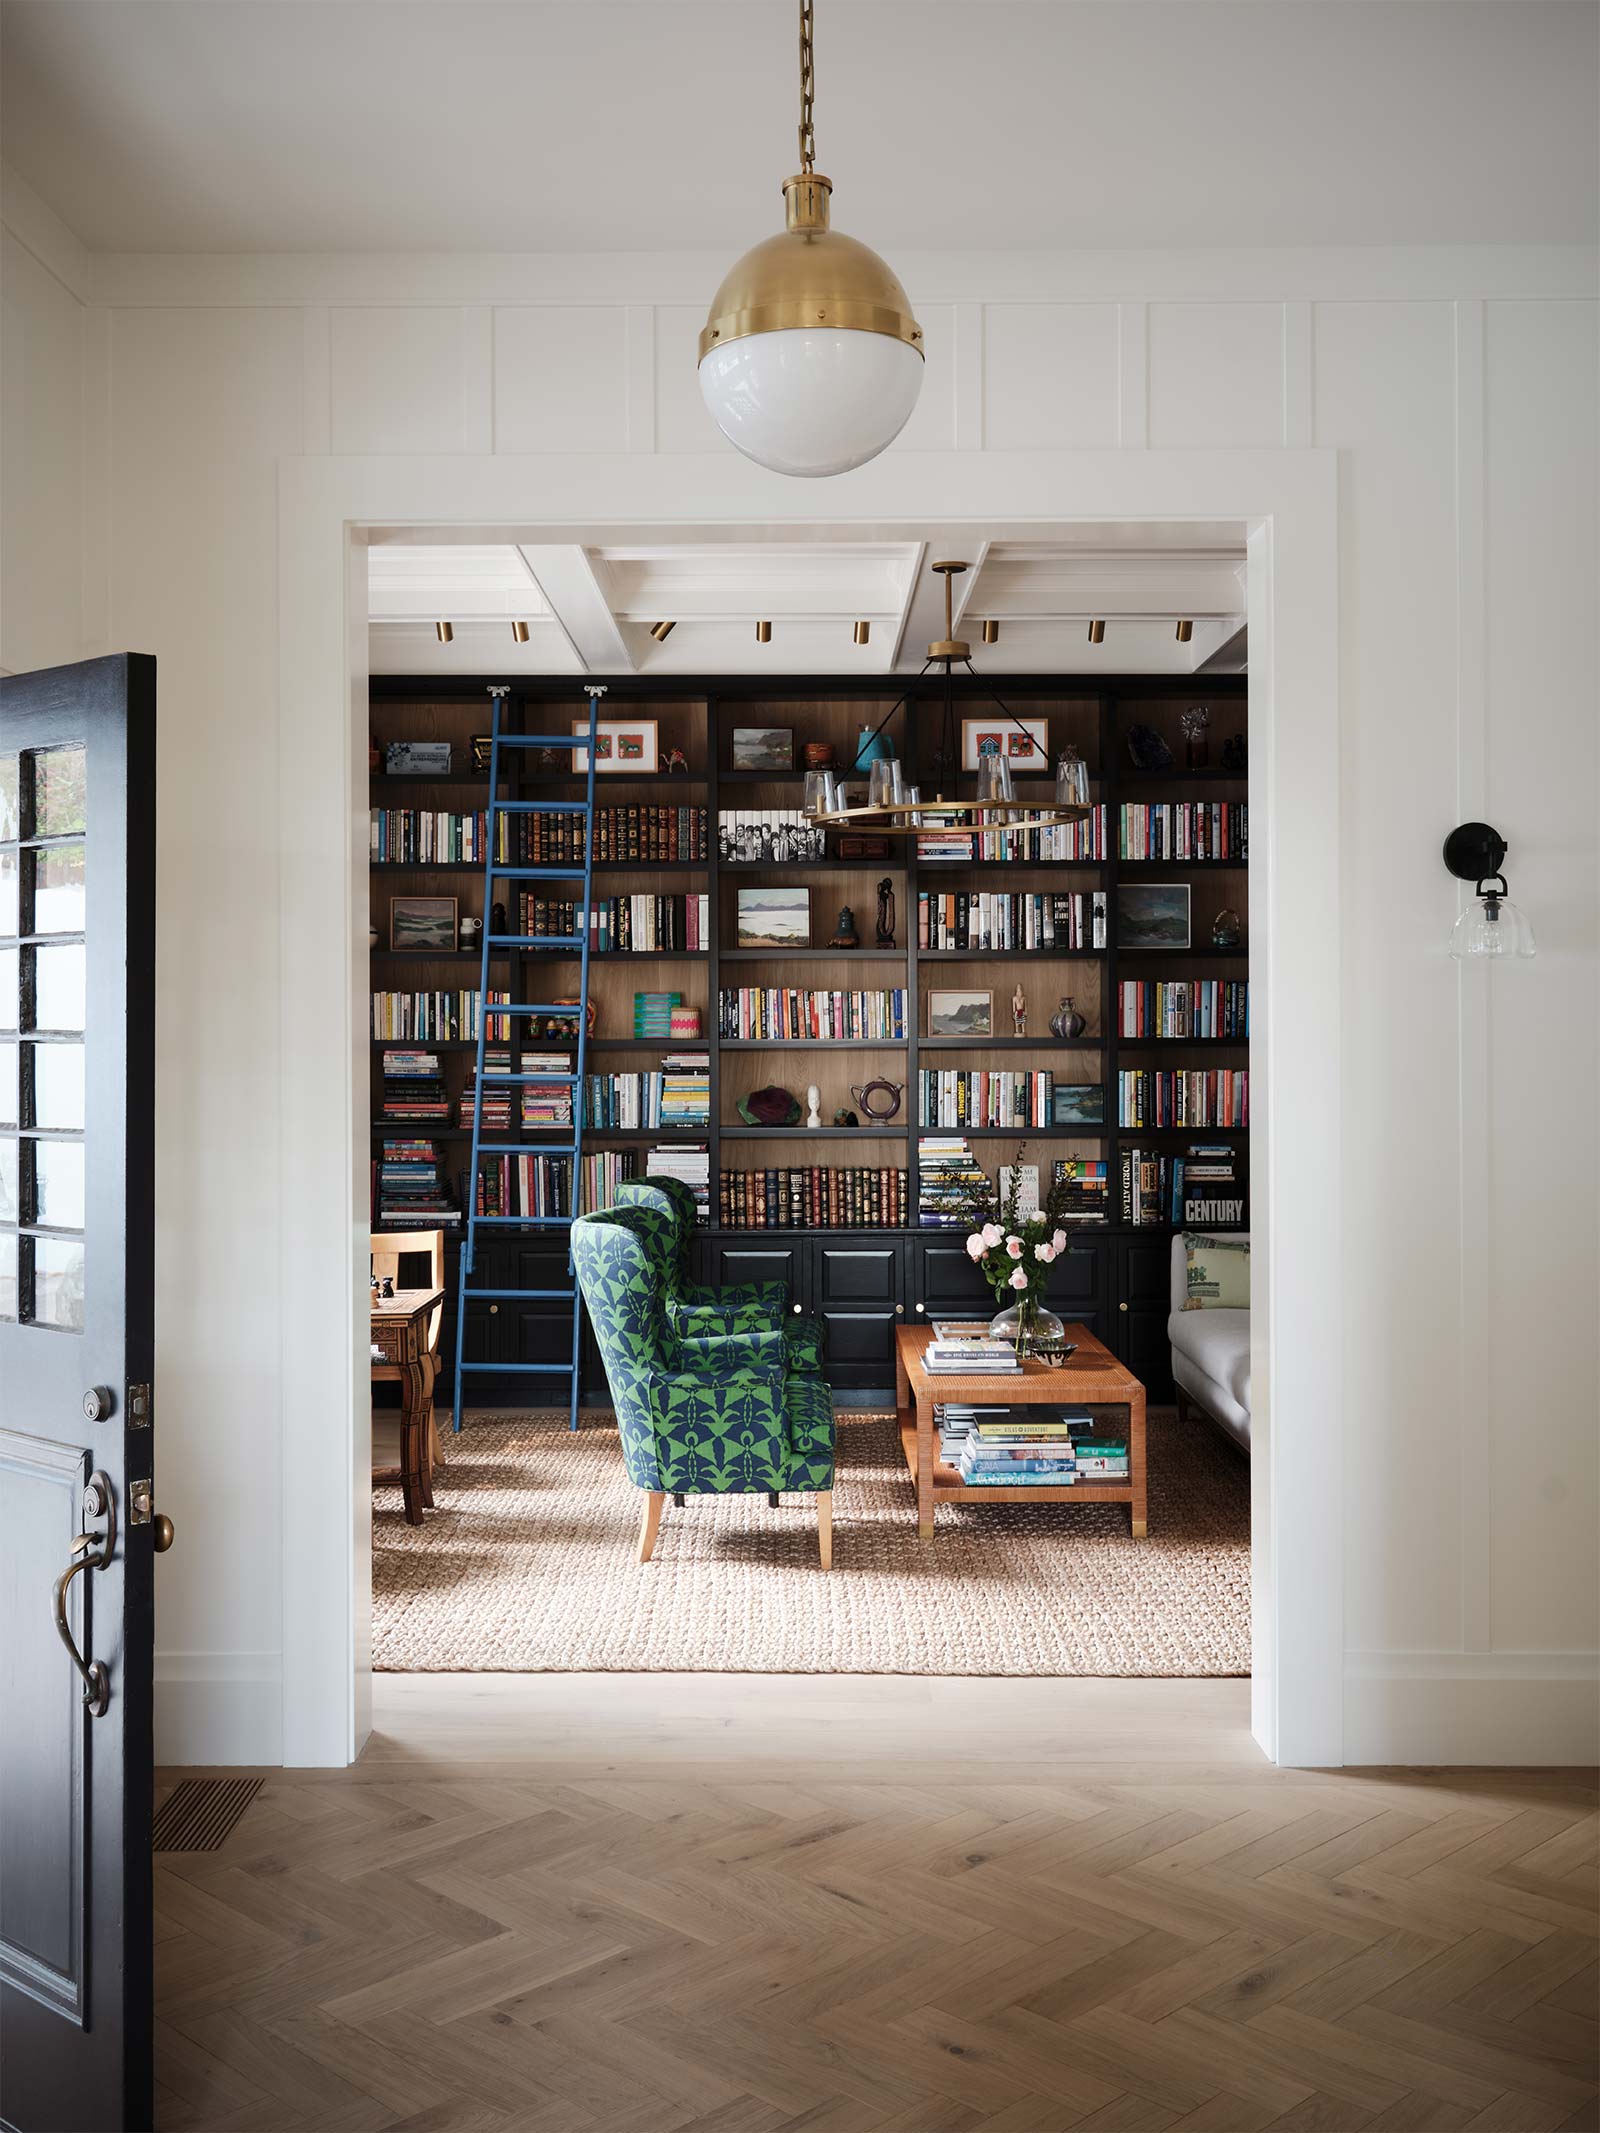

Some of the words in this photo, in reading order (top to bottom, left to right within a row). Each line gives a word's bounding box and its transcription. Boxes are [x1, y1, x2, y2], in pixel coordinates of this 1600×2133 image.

[1122, 1158, 1131, 1189] WORLD
[1122, 1189, 1131, 1214] ATLAS
[1185, 1200, 1244, 1222] CENTURY
[974, 1460, 1000, 1472] GAIA
